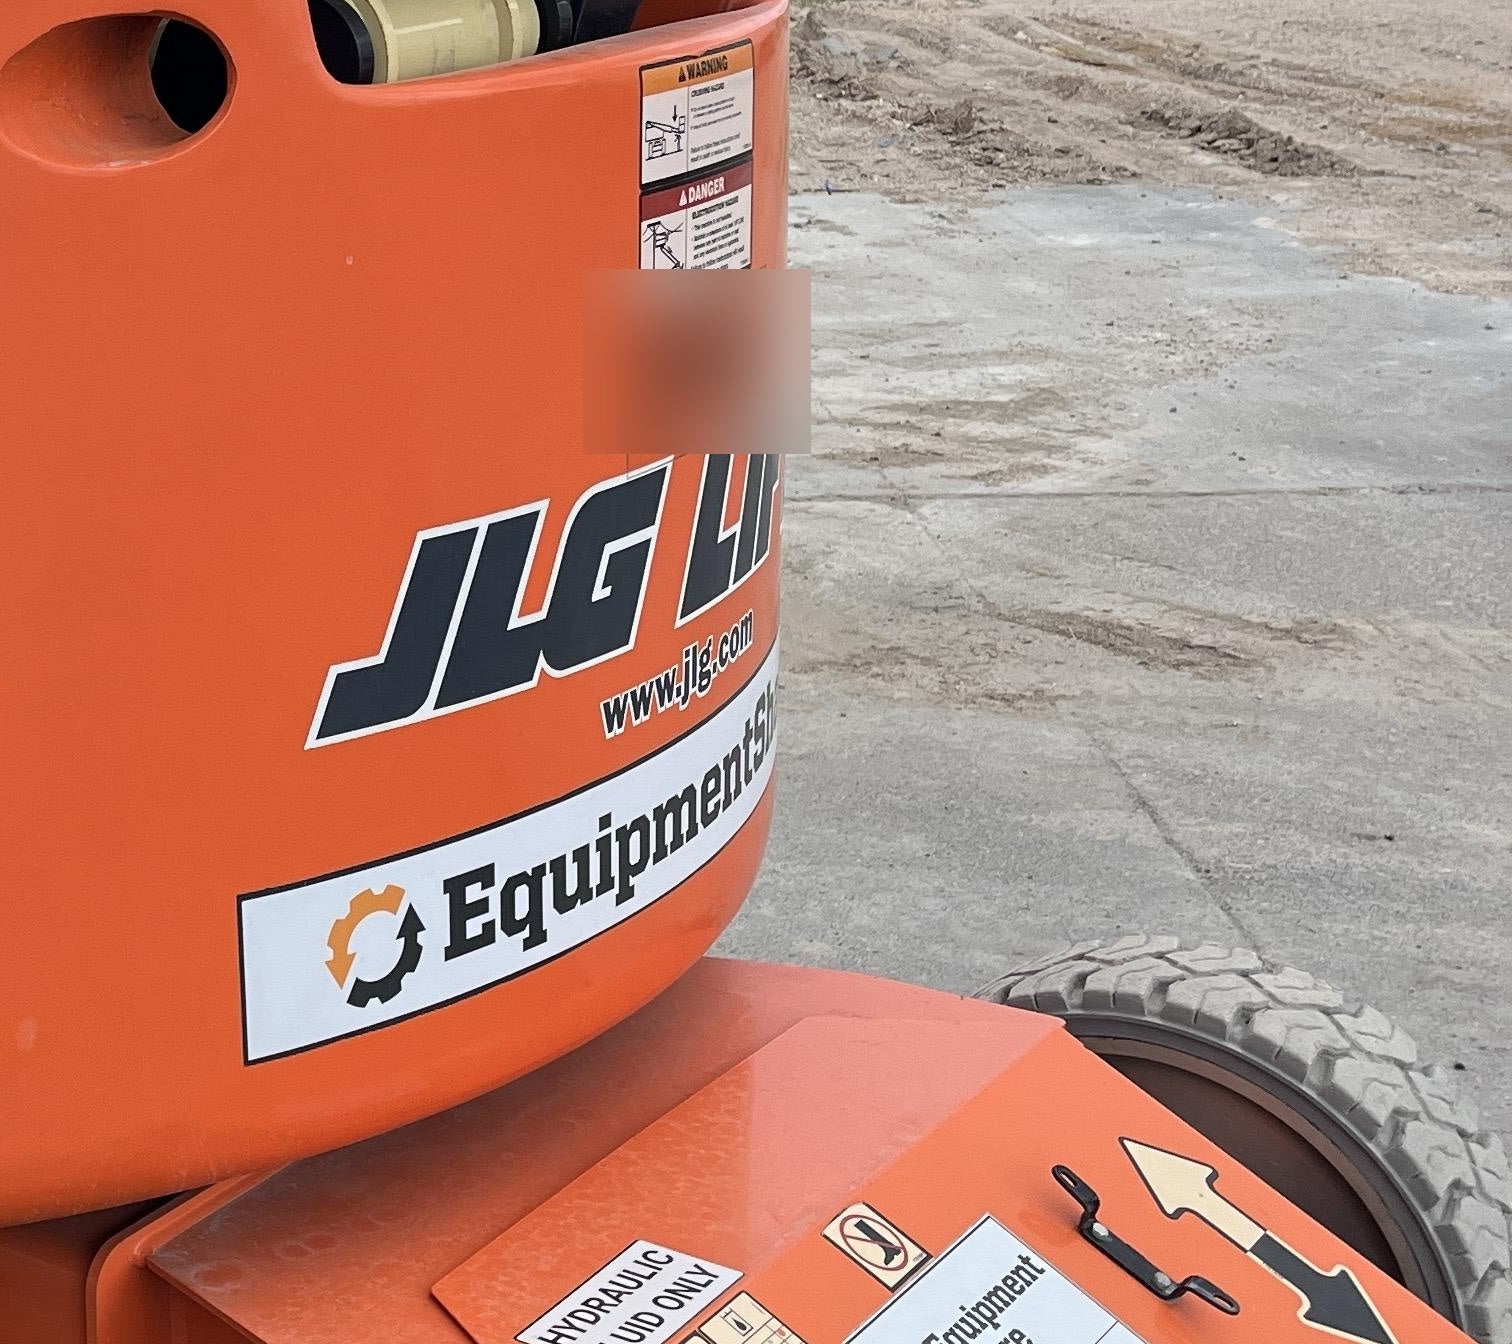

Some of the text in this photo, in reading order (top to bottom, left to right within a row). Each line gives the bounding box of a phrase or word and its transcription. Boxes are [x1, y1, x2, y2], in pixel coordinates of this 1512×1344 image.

[686, 55, 728, 81] WARNING
[688, 176, 725, 204] DANGER
[310, 459, 673, 745] JLG
[602, 612, 754, 738] www.jlg.com
[651, 1263, 720, 1311] ONLY
